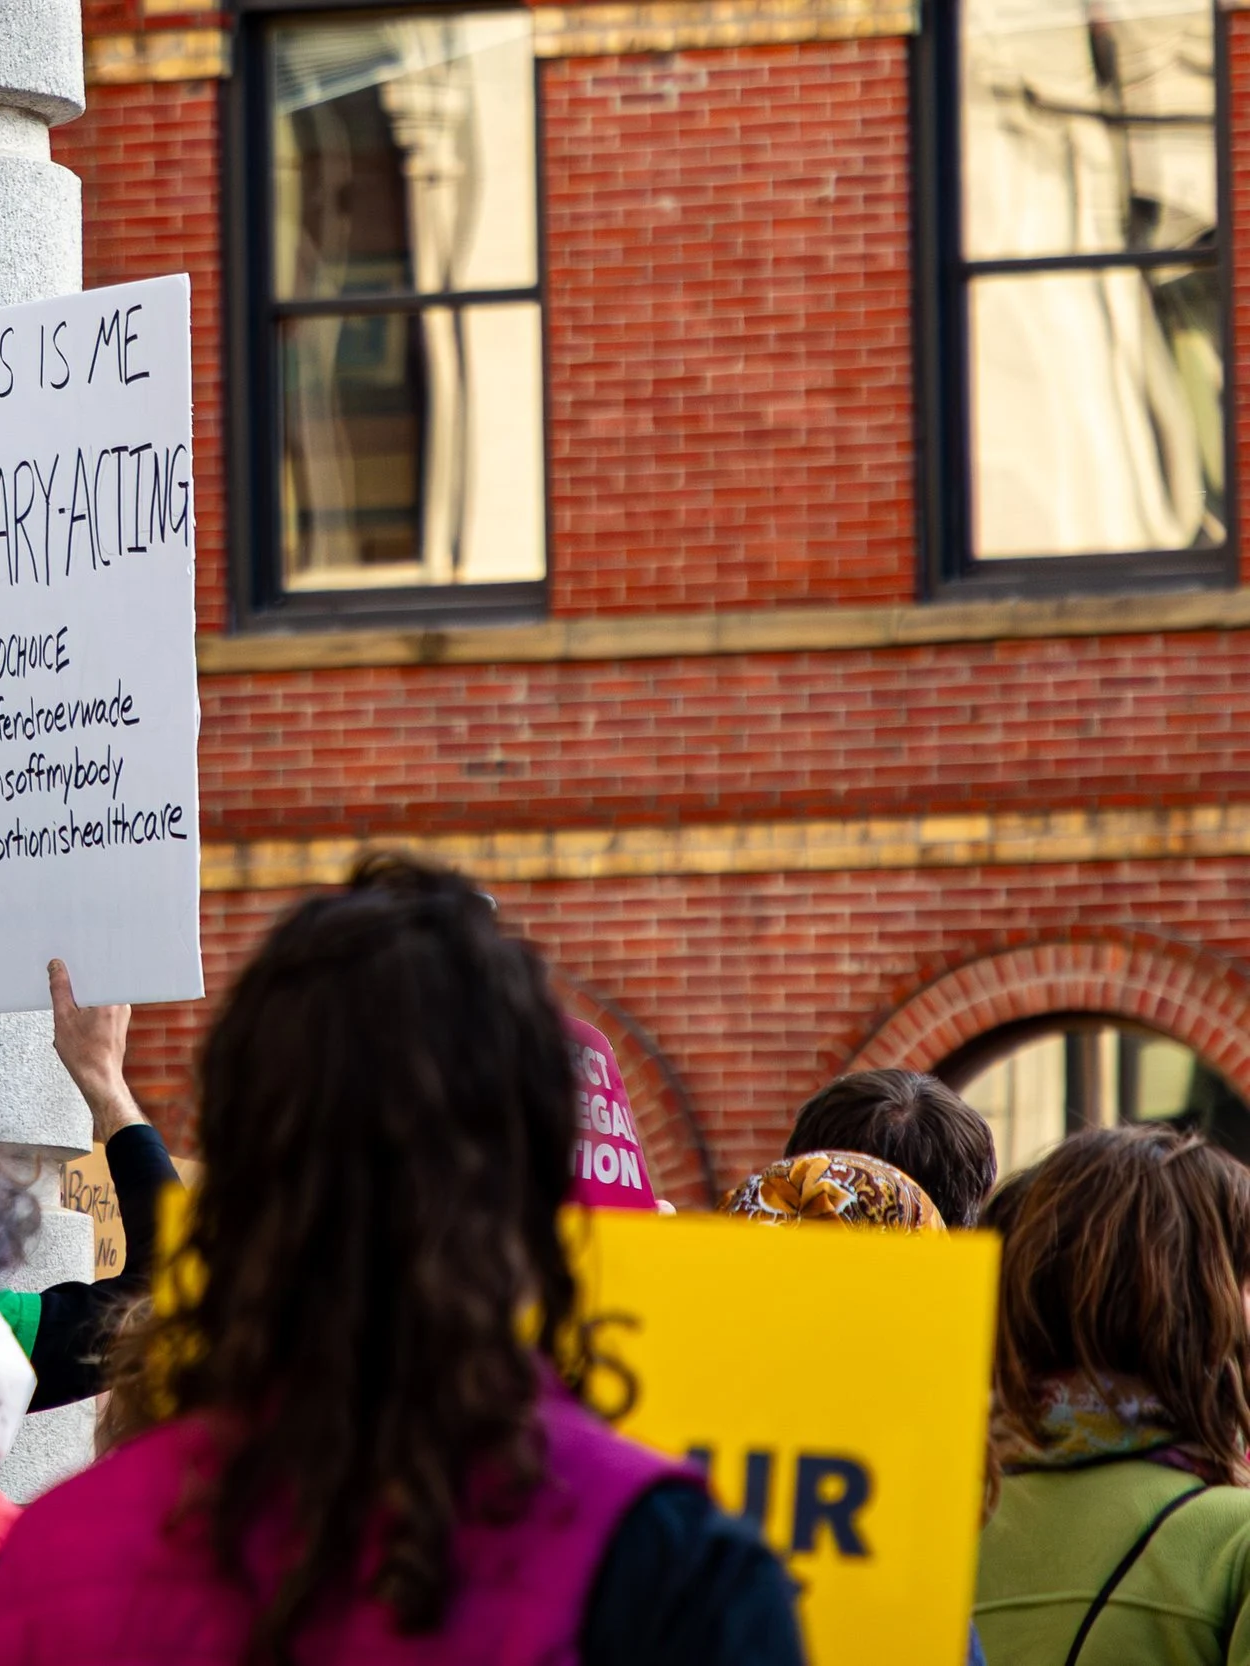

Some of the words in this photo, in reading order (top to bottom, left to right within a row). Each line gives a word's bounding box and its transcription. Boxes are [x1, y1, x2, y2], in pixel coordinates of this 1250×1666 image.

[39, 321, 70, 390] IS
[87, 304, 150, 386] ME
[575, 1092, 638, 1146] EGAL
[572, 1140, 643, 1190] TION
